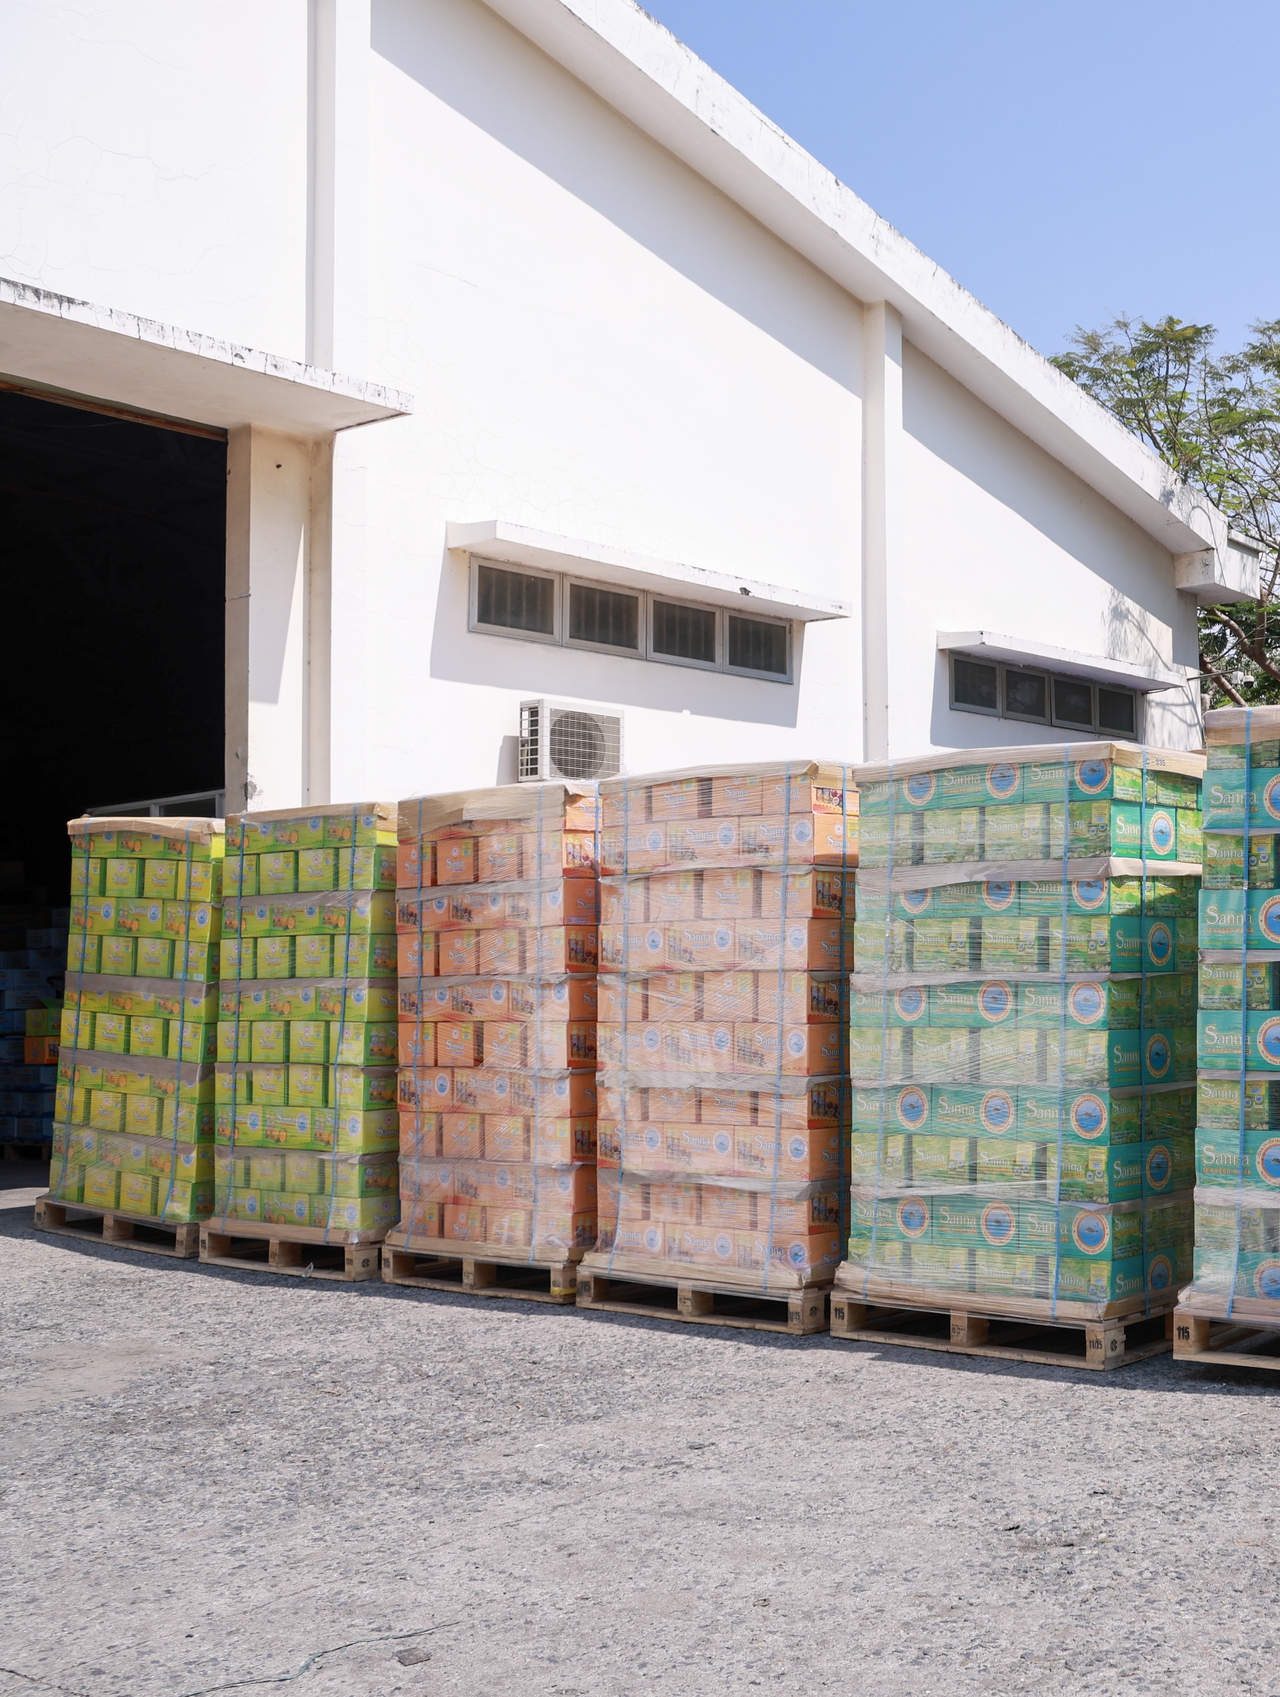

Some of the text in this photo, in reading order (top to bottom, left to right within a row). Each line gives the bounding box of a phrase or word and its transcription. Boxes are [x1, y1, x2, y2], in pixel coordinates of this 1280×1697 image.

[944, 770, 980, 785] Sanna
[1116, 816, 1143, 835] Sann
[1207, 844, 1244, 858] Sanna
[1202, 965, 1239, 979] Sanna
[937, 987, 973, 1005] Sanna
[1201, 1083, 1238, 1098] Sanna
[938, 1097, 974, 1115] Sanna
[940, 1207, 976, 1226] Sanna
[834, 1307, 845, 1320] 115
[1177, 1326, 1190, 1340] 115
